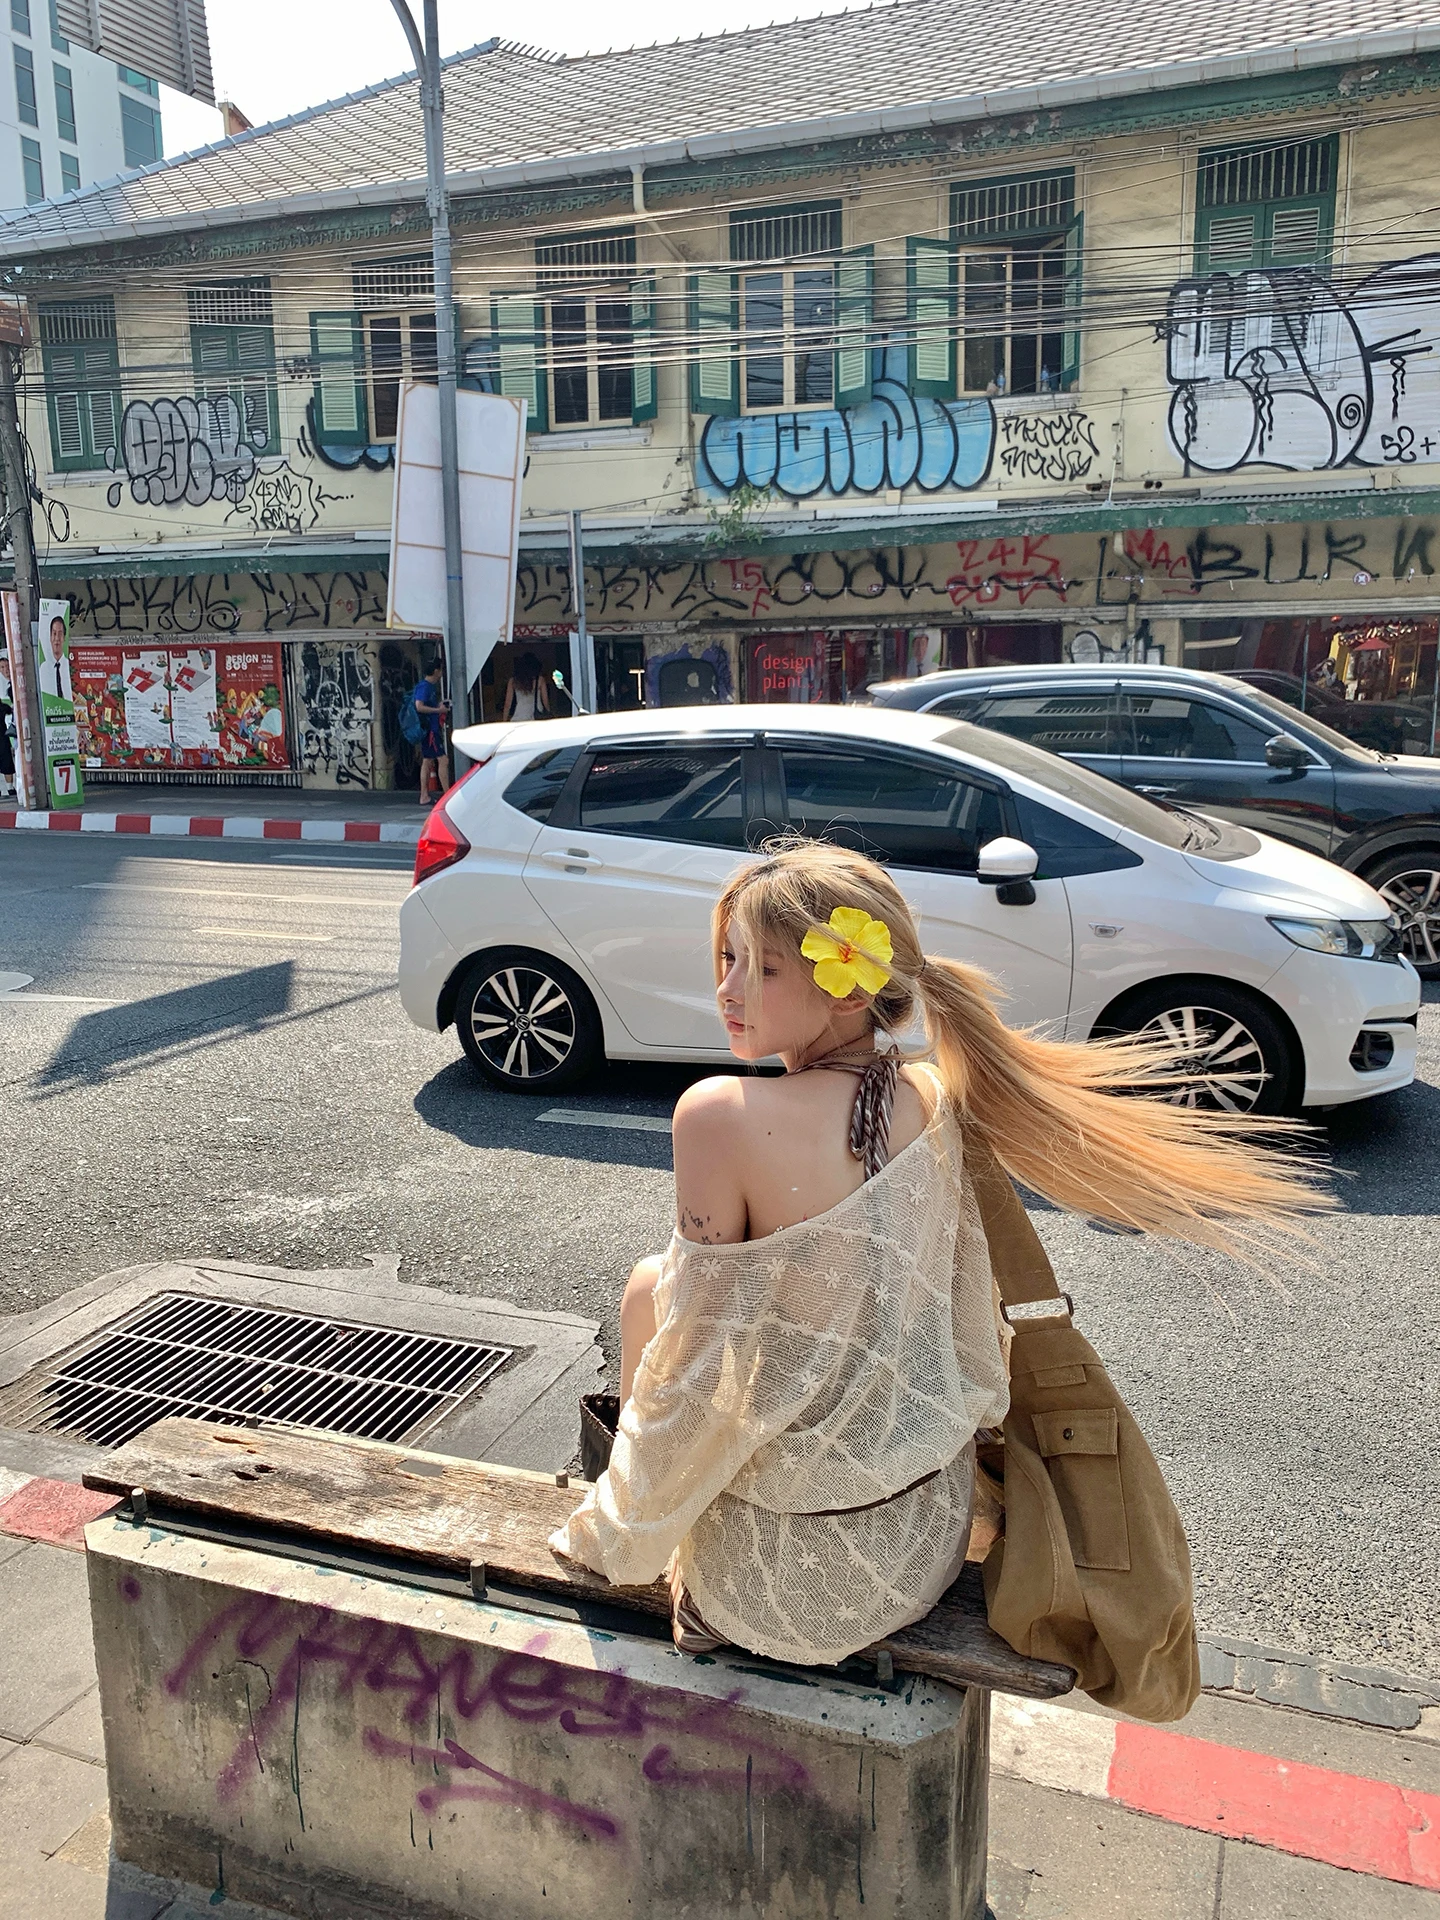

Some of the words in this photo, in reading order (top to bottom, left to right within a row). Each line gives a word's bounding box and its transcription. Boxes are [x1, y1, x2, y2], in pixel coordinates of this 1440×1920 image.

[225, 652, 259, 664] DESIGN
[763, 653, 814, 674] design
[58, 767, 71, 794] 7
